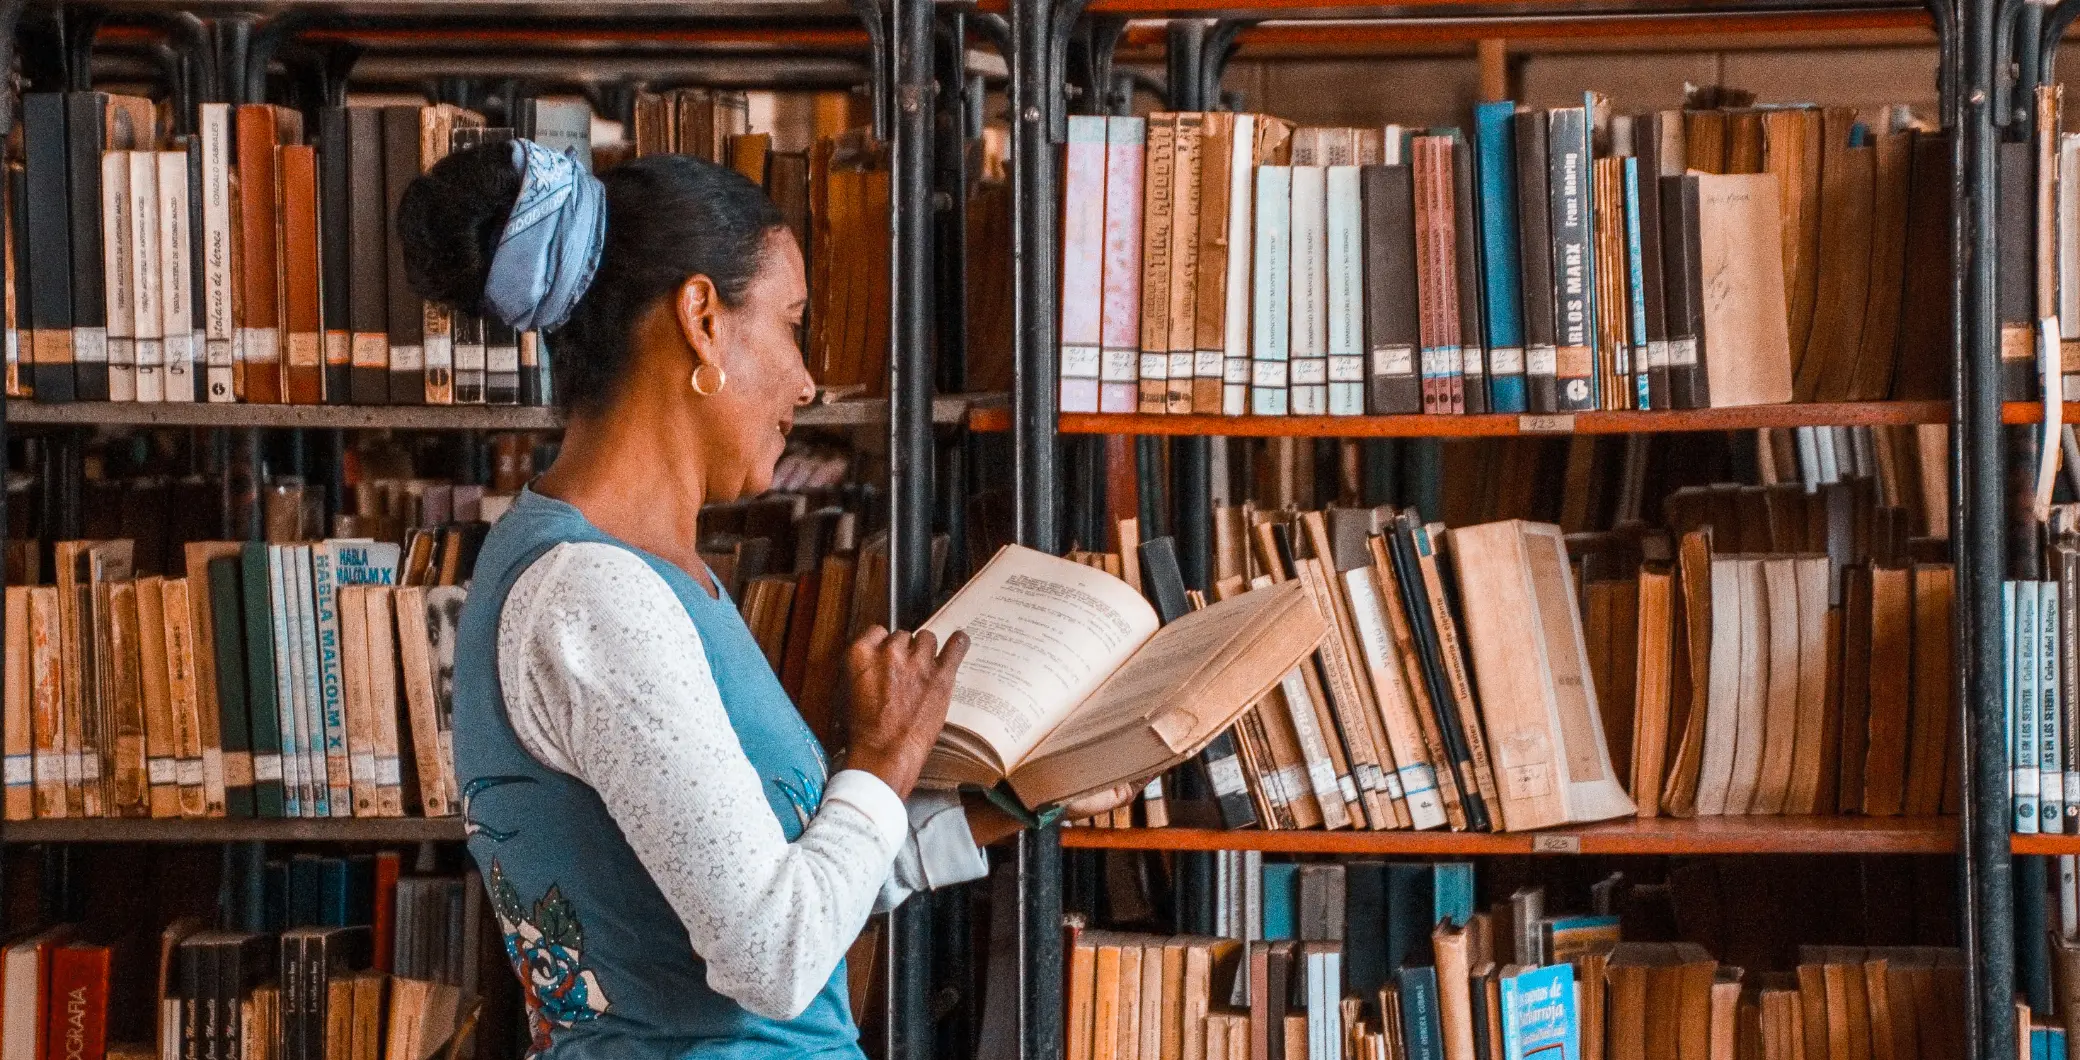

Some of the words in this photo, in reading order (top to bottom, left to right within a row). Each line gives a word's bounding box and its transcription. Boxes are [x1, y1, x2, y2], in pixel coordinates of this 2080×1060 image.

[1564, 153, 1578, 196] Mehring
[1566, 198, 1579, 227] Franz
[211, 272, 221, 286] de
[1566, 243, 1582, 294] MARX
[211, 290, 224, 336] stolario
[1568, 300, 1584, 346] RLOS
[1530, 418, 1555, 430] 923
[340, 548, 369, 566] HABLA
[336, 566, 379, 585] MALCOLM
[381, 567, 392, 585] X
[316, 555, 334, 622] HABLA
[1373, 627, 1391, 668] OBAMA
[1445, 631, 1452, 643] de
[1448, 644, 1462, 681] memoria
[2025, 660, 2033, 681] Carlos
[2046, 660, 2054, 681] Carlos
[322, 630, 342, 727] MALCOLM
[1458, 682, 1467, 699] Una
[2044, 688, 2055, 721] SETENTA
[2022, 722, 2033, 738] LOS
[2044, 723, 2054, 738] LOS
[330, 735, 342, 749] X
[2023, 740, 2032, 750] EN
[2044, 740, 2054, 750] EN
